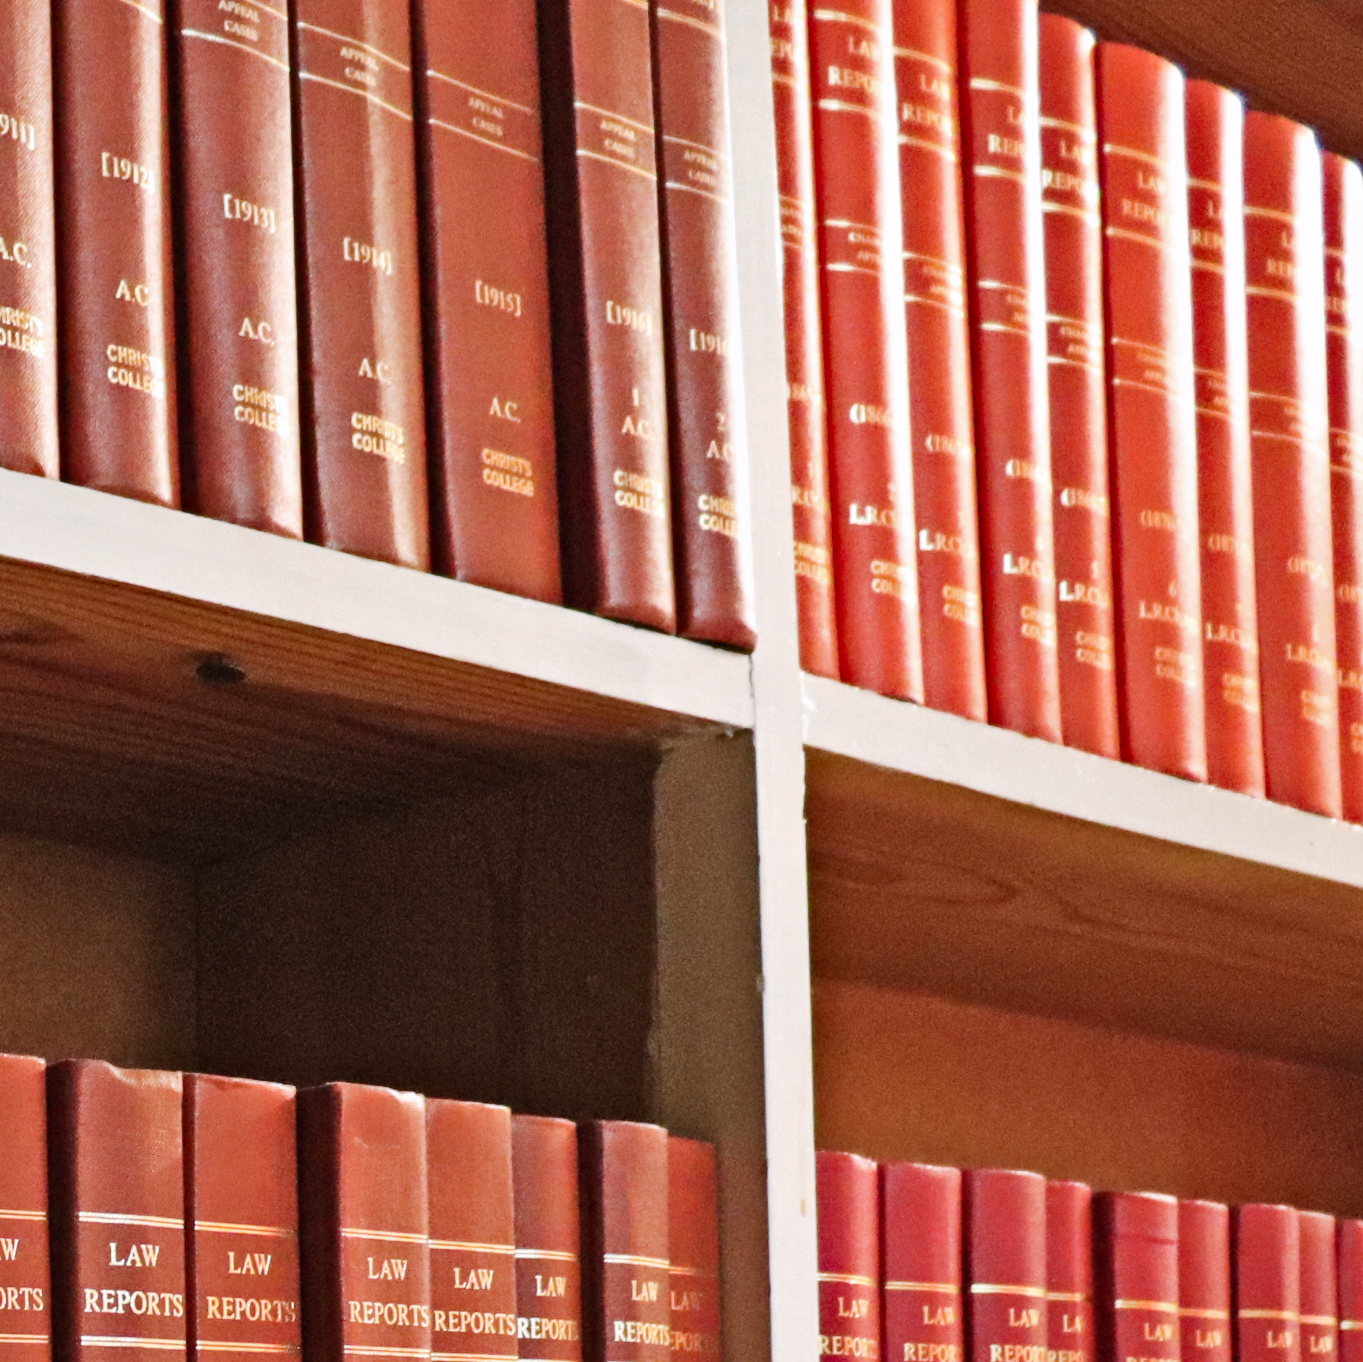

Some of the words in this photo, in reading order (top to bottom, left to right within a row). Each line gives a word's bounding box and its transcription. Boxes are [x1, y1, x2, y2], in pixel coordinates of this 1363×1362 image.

[101, 151, 156, 195] [1912]
[222, 193, 276, 233] [1913]
[342, 236, 393, 275] [1914]
[475, 280, 522, 317] [1915]
[239, 317, 276, 346] A.C.
[606, 300, 652, 336] [1916]
[490, 398, 522, 423] A.C.
[483, 468, 535, 498] COLLEGE
[109, 1242, 160, 1268] LAW
[228, 1251, 272, 1276] LAW
[367, 1257, 408, 1281] LAW
[454, 1267, 494, 1291] LAW
[535, 1275, 567, 1298] LAW
[631, 1280, 658, 1302] LAW
[84, 1288, 184, 1318] REPORTS
[206, 1296, 296, 1324] REPORTS
[348, 1300, 430, 1328] REPORTS
[434, 1309, 516, 1336] REPORTS
[516, 1317, 579, 1342] REPORTS
[613, 1320, 670, 1347] REPORTS
